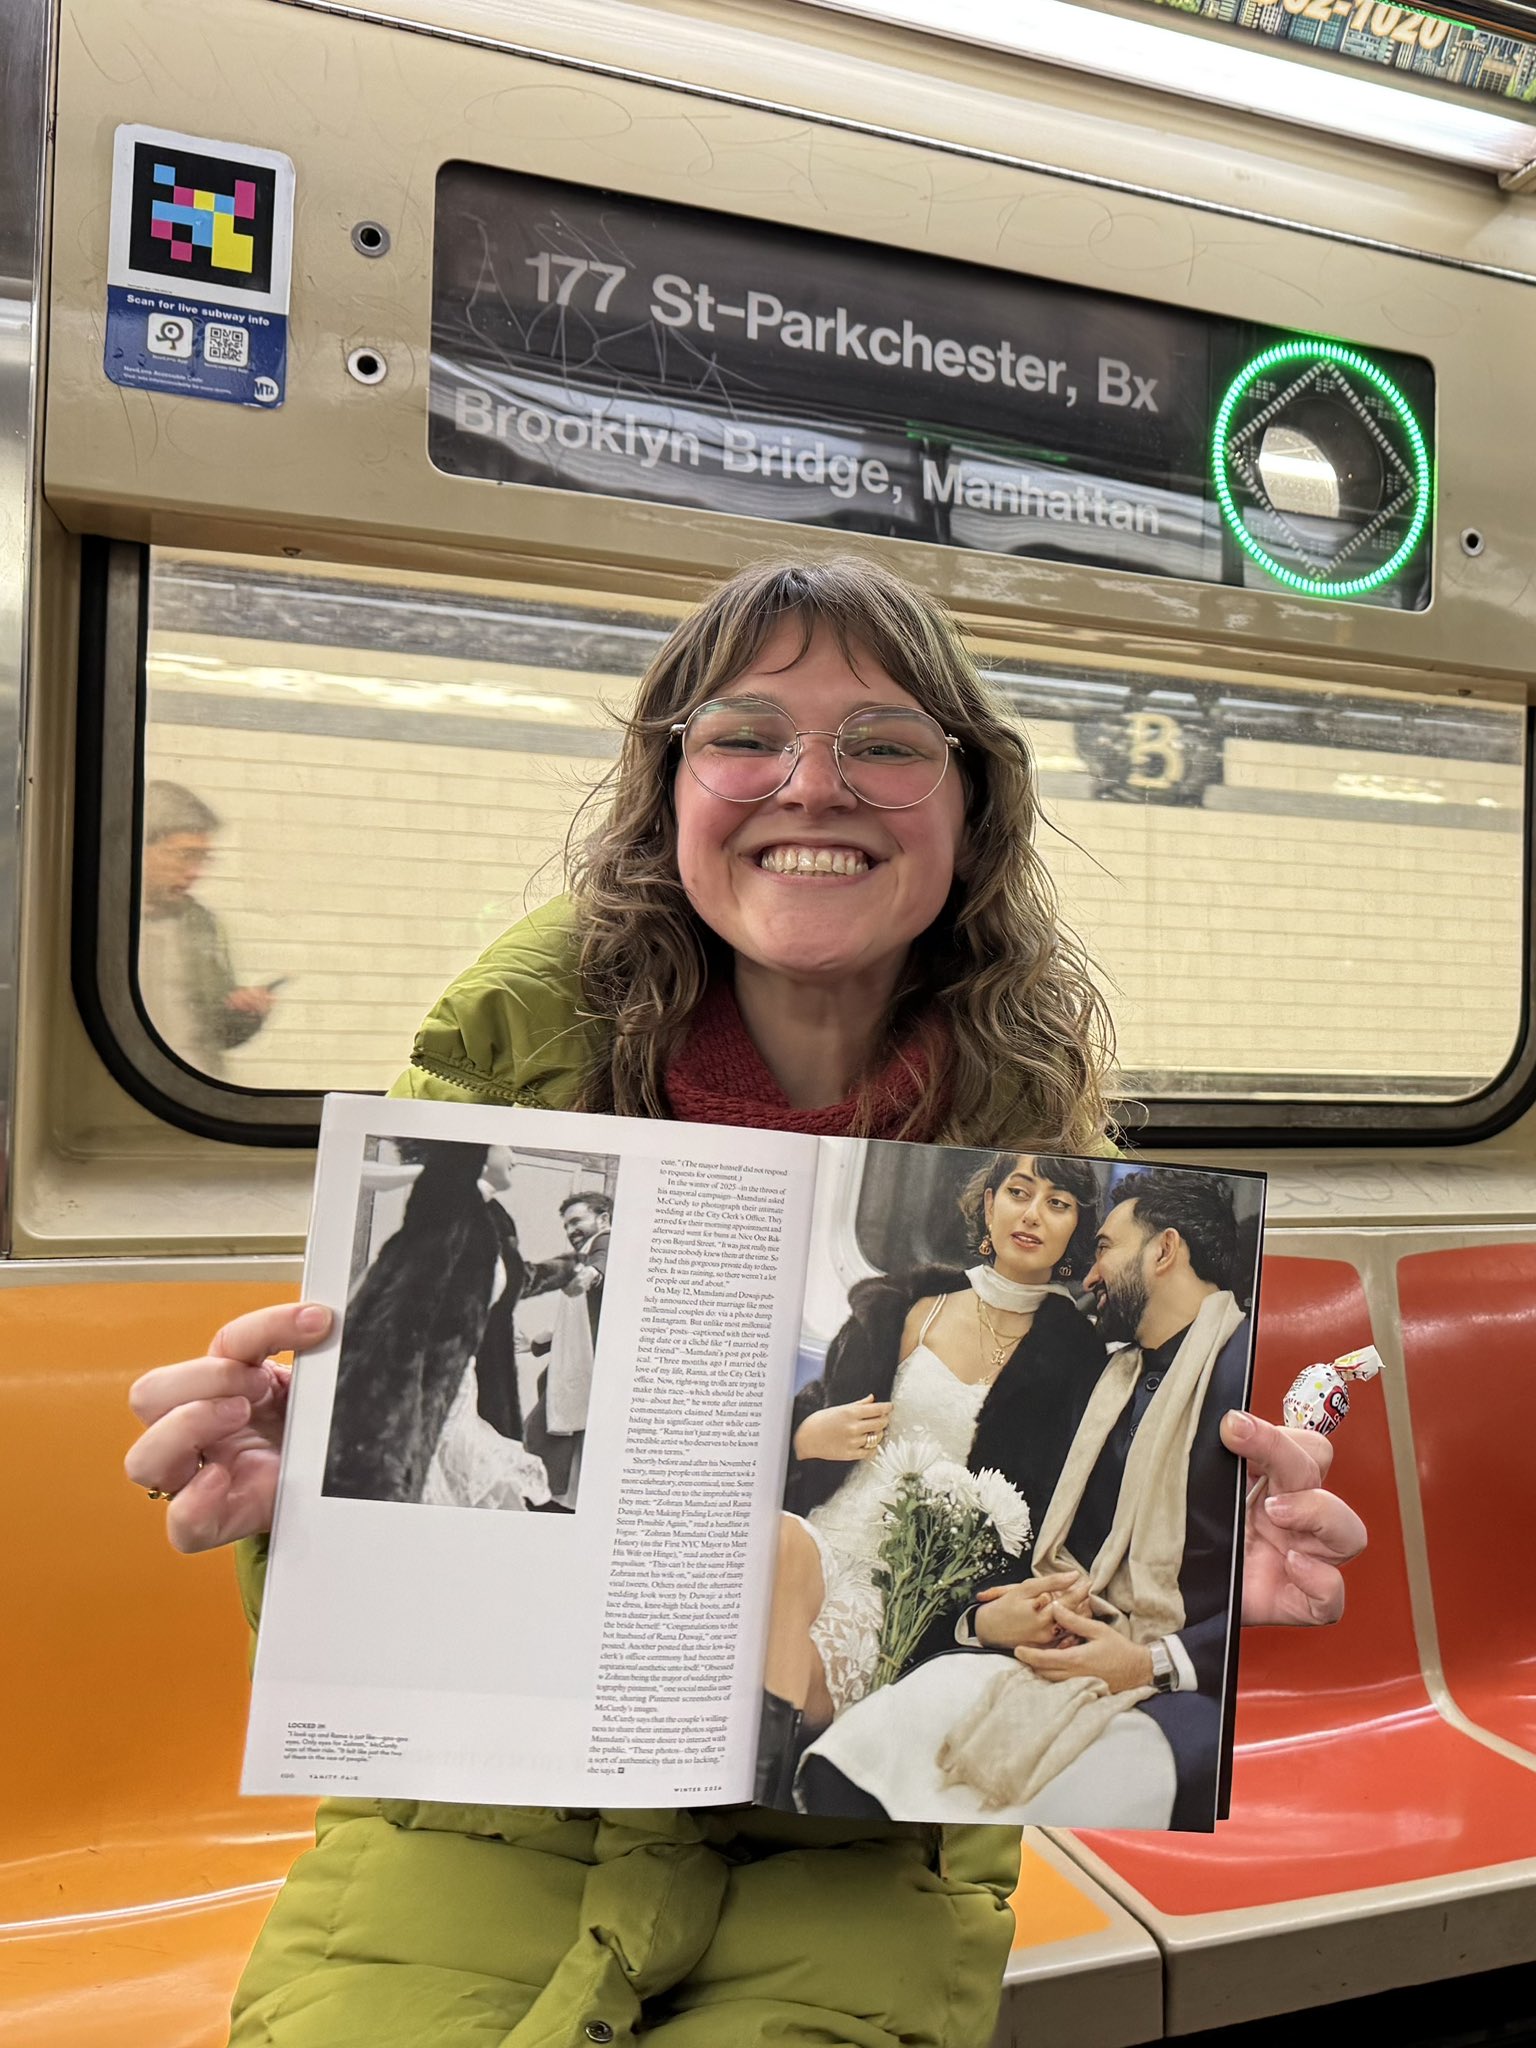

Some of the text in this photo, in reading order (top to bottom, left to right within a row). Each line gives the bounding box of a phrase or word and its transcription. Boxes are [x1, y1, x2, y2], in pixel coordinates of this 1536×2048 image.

[127, 295, 270, 326] Scan for live subway info
[525, 252, 626, 314] 177
[1098, 358, 1159, 413] Bx
[254, 380, 274, 396] MTA
[455, 389, 1160, 534] Brooklyn Bridge, Manhattan
[1121, 712, 1185, 789] B
